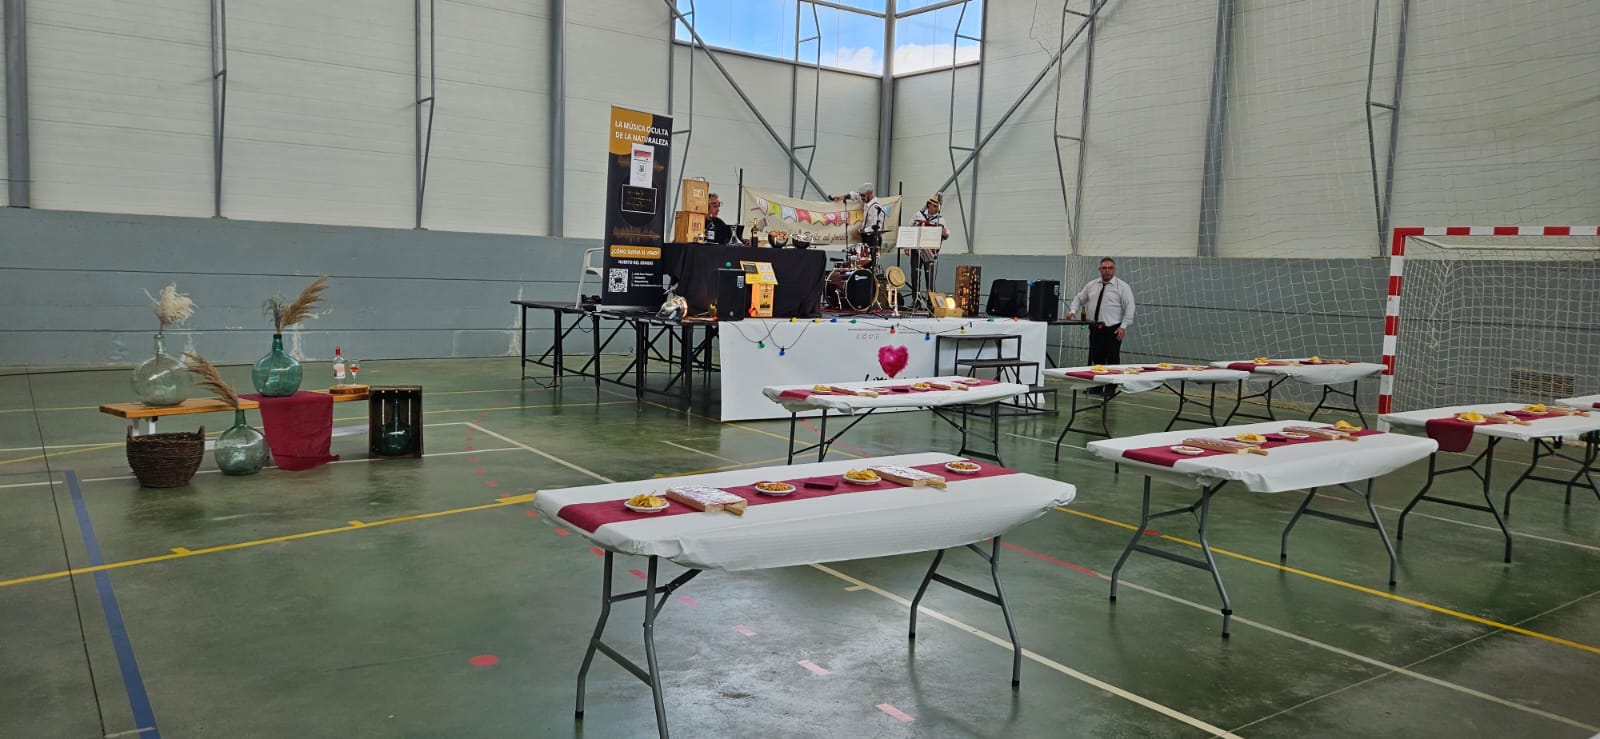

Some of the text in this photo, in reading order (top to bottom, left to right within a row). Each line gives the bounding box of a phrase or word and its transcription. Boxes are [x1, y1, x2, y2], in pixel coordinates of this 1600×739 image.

[624, 121, 646, 132] MÚSICA
[647, 126, 668, 136] OCULTA
[615, 131, 668, 146] DE LA NATURALEZA
